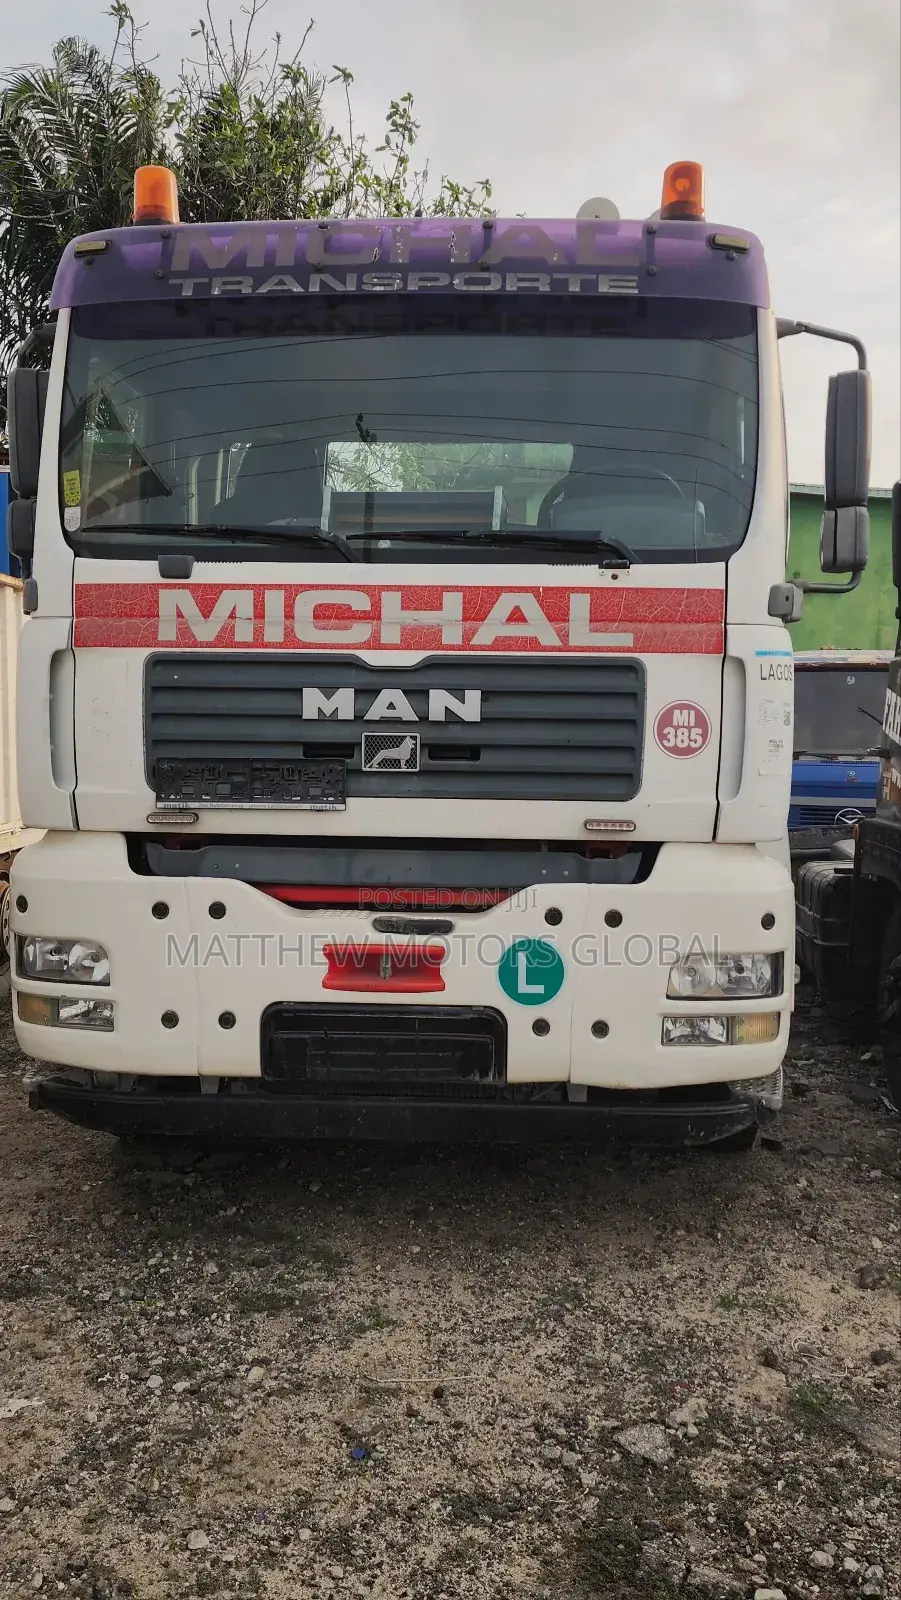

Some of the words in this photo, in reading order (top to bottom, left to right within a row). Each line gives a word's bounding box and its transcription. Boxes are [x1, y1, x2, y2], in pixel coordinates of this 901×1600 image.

[171, 224, 639, 271] MICHAL
[168, 272, 639, 296] TRANSPORTE
[158, 589, 634, 647] MICHAL
[759, 663, 793, 681] LAGOS
[302, 687, 482, 722] MAN
[672, 709, 696, 727] MI
[662, 726, 703, 748] 385
[163, 802, 191, 810] matik
[310, 803, 338, 811] matik
[517, 951, 545, 994] L
